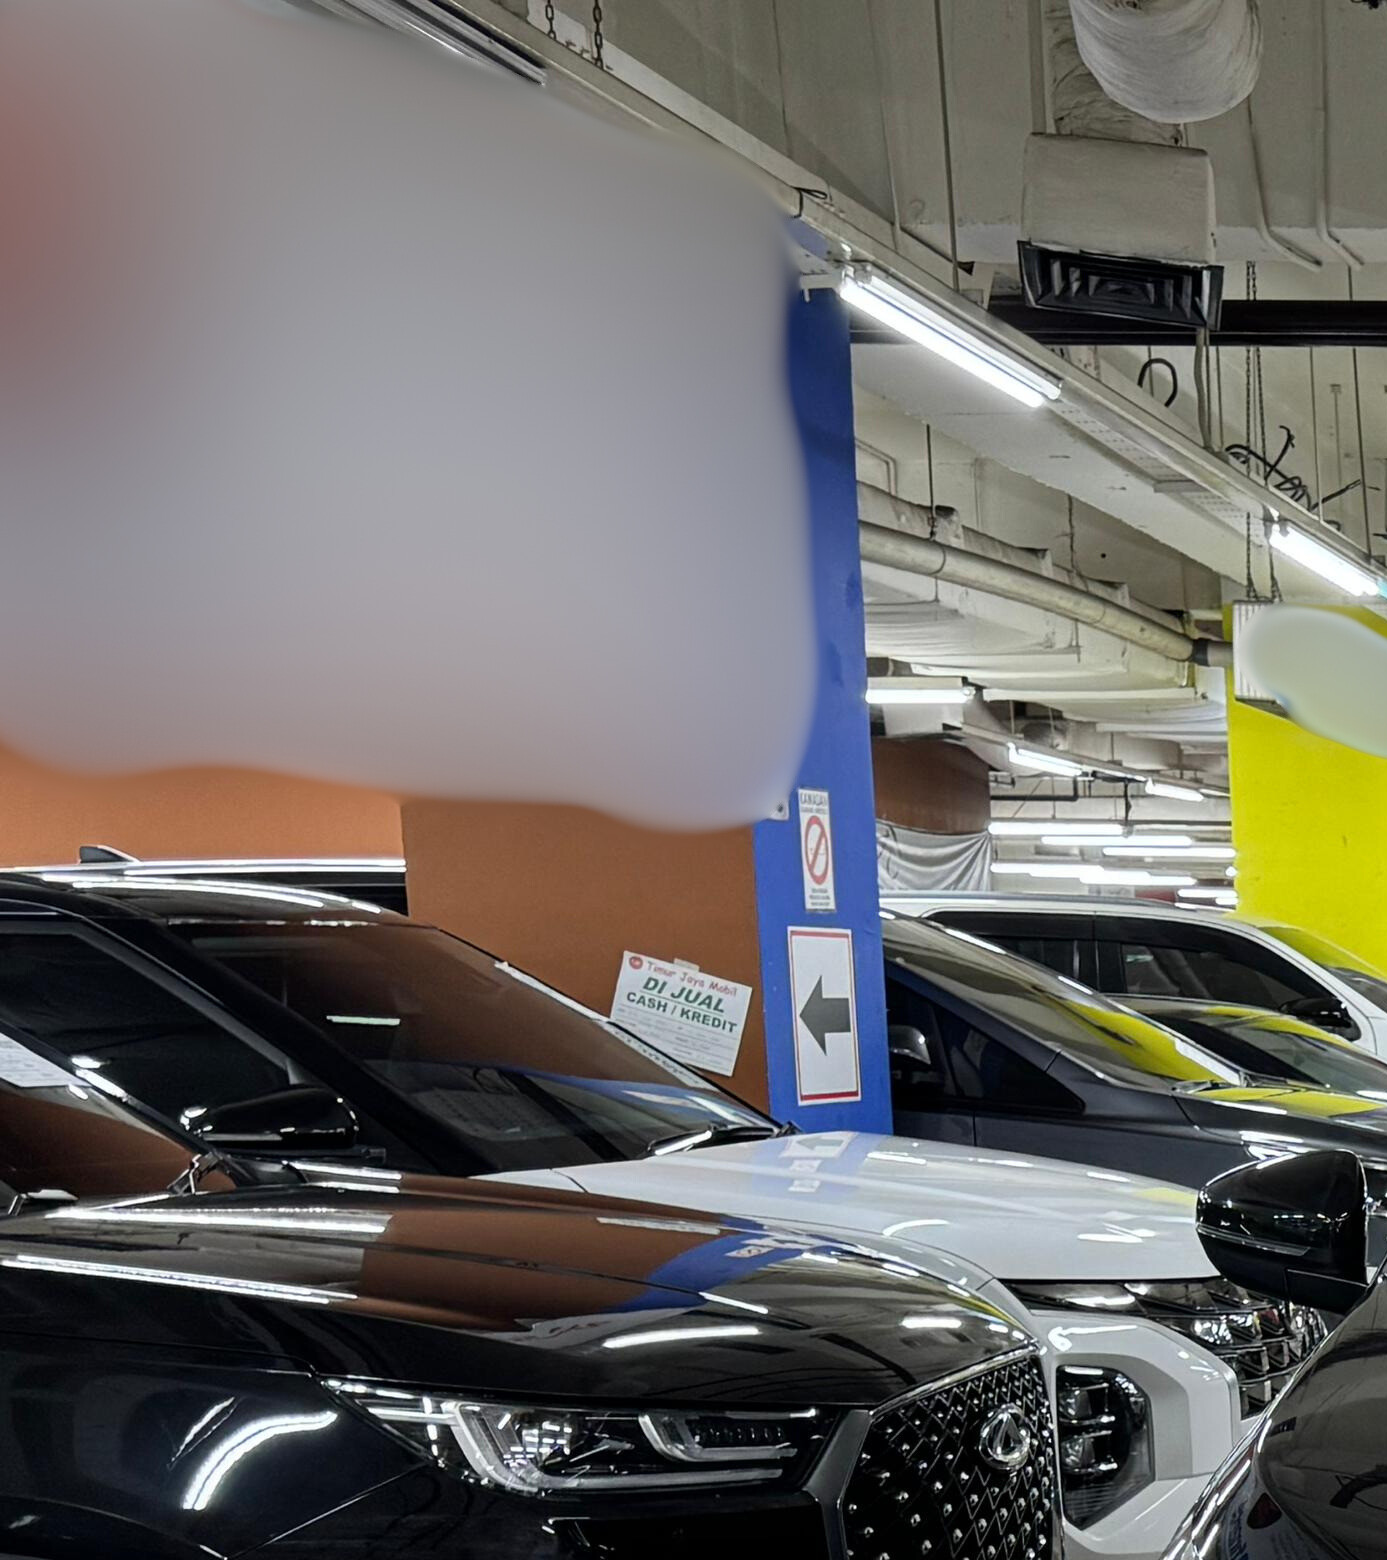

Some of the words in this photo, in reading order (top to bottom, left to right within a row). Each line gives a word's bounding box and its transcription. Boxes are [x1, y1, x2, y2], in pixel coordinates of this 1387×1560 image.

[626, 992, 668, 1013] CASH
[680, 1007, 738, 1033] KREDIT
[642, 977, 668, 994] DI
[670, 986, 726, 1013] JUAL
